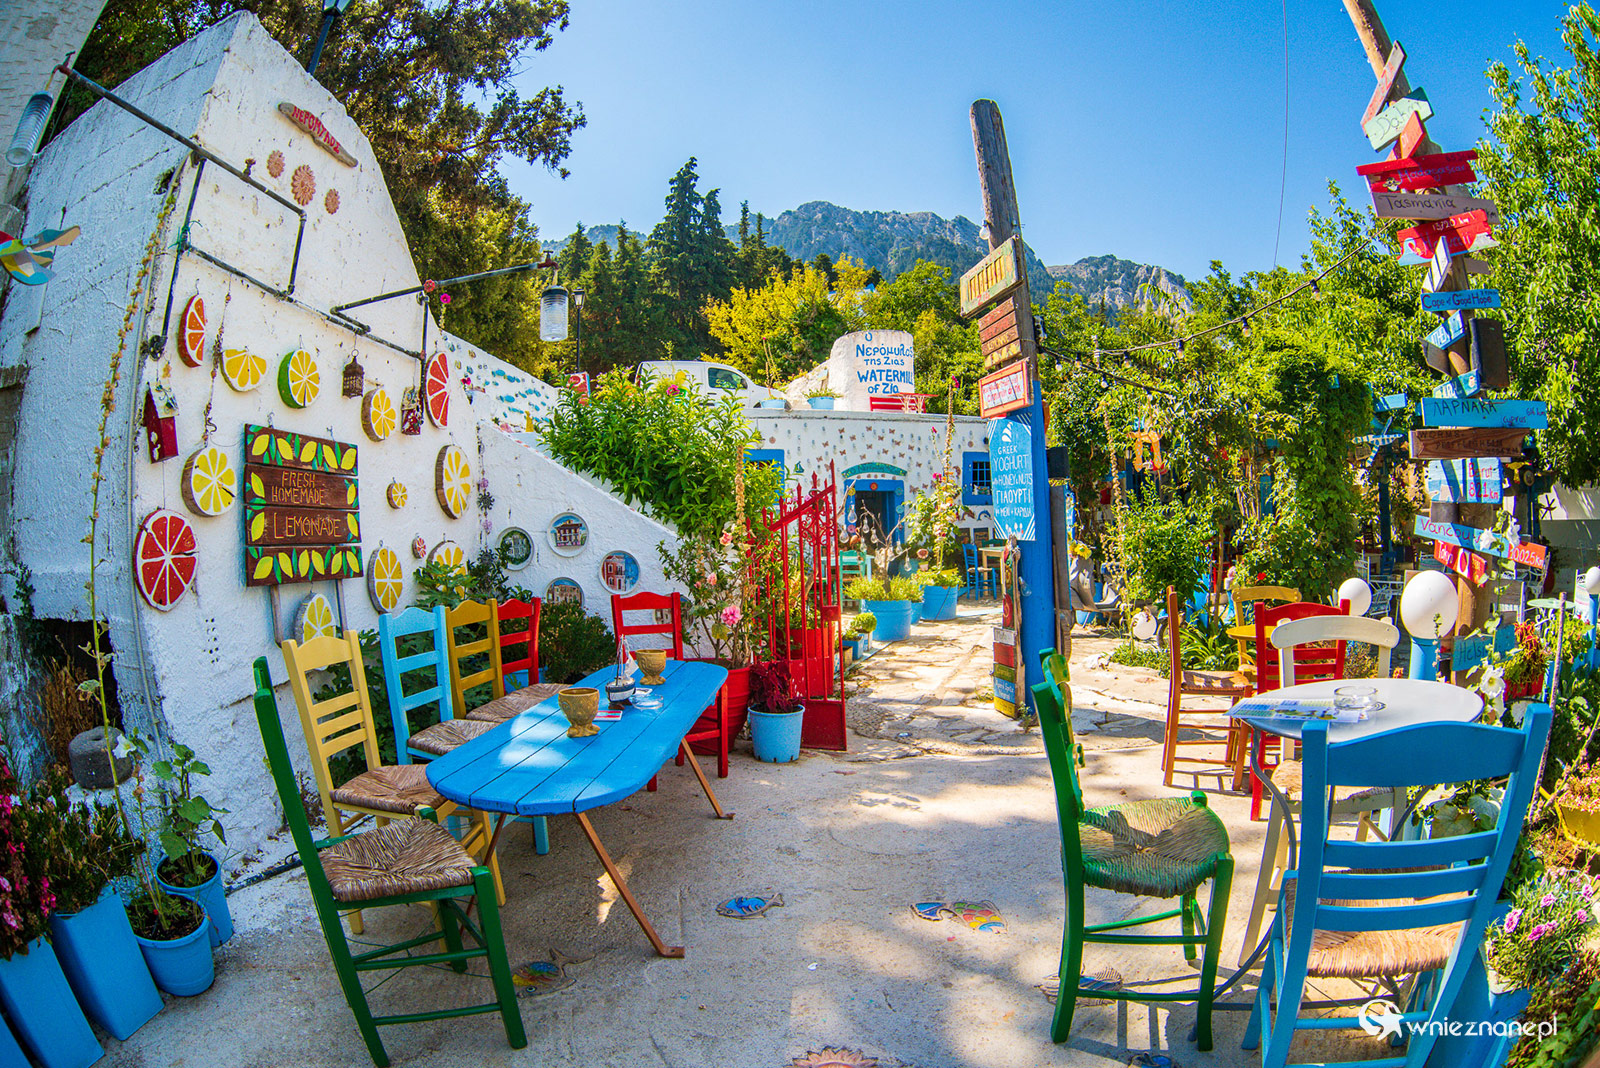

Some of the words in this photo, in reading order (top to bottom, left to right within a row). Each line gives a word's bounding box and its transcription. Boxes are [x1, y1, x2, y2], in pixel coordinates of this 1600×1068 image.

[1398, 164, 1465, 183] Madagascar
[1380, 195, 1456, 211] Tasmania
[1422, 294, 1445, 309] Cape
[1452, 293, 1472, 307] Good
[1471, 292, 1492, 306] Hope
[857, 369, 914, 385] WATERMILL
[867, 384, 880, 394] of
[997, 445, 1018, 455] GREEK
[993, 454, 1029, 472] YOGHURT
[283, 472, 315, 488] FRESH
[271, 486, 326, 505] HOMEMADE
[996, 488, 1031, 504] ΓΙΑΟΥΡΤΙ
[1468, 482, 1489, 498] 821
[1489, 488, 1499, 500] km
[273, 513, 342, 539] LEMONADE
